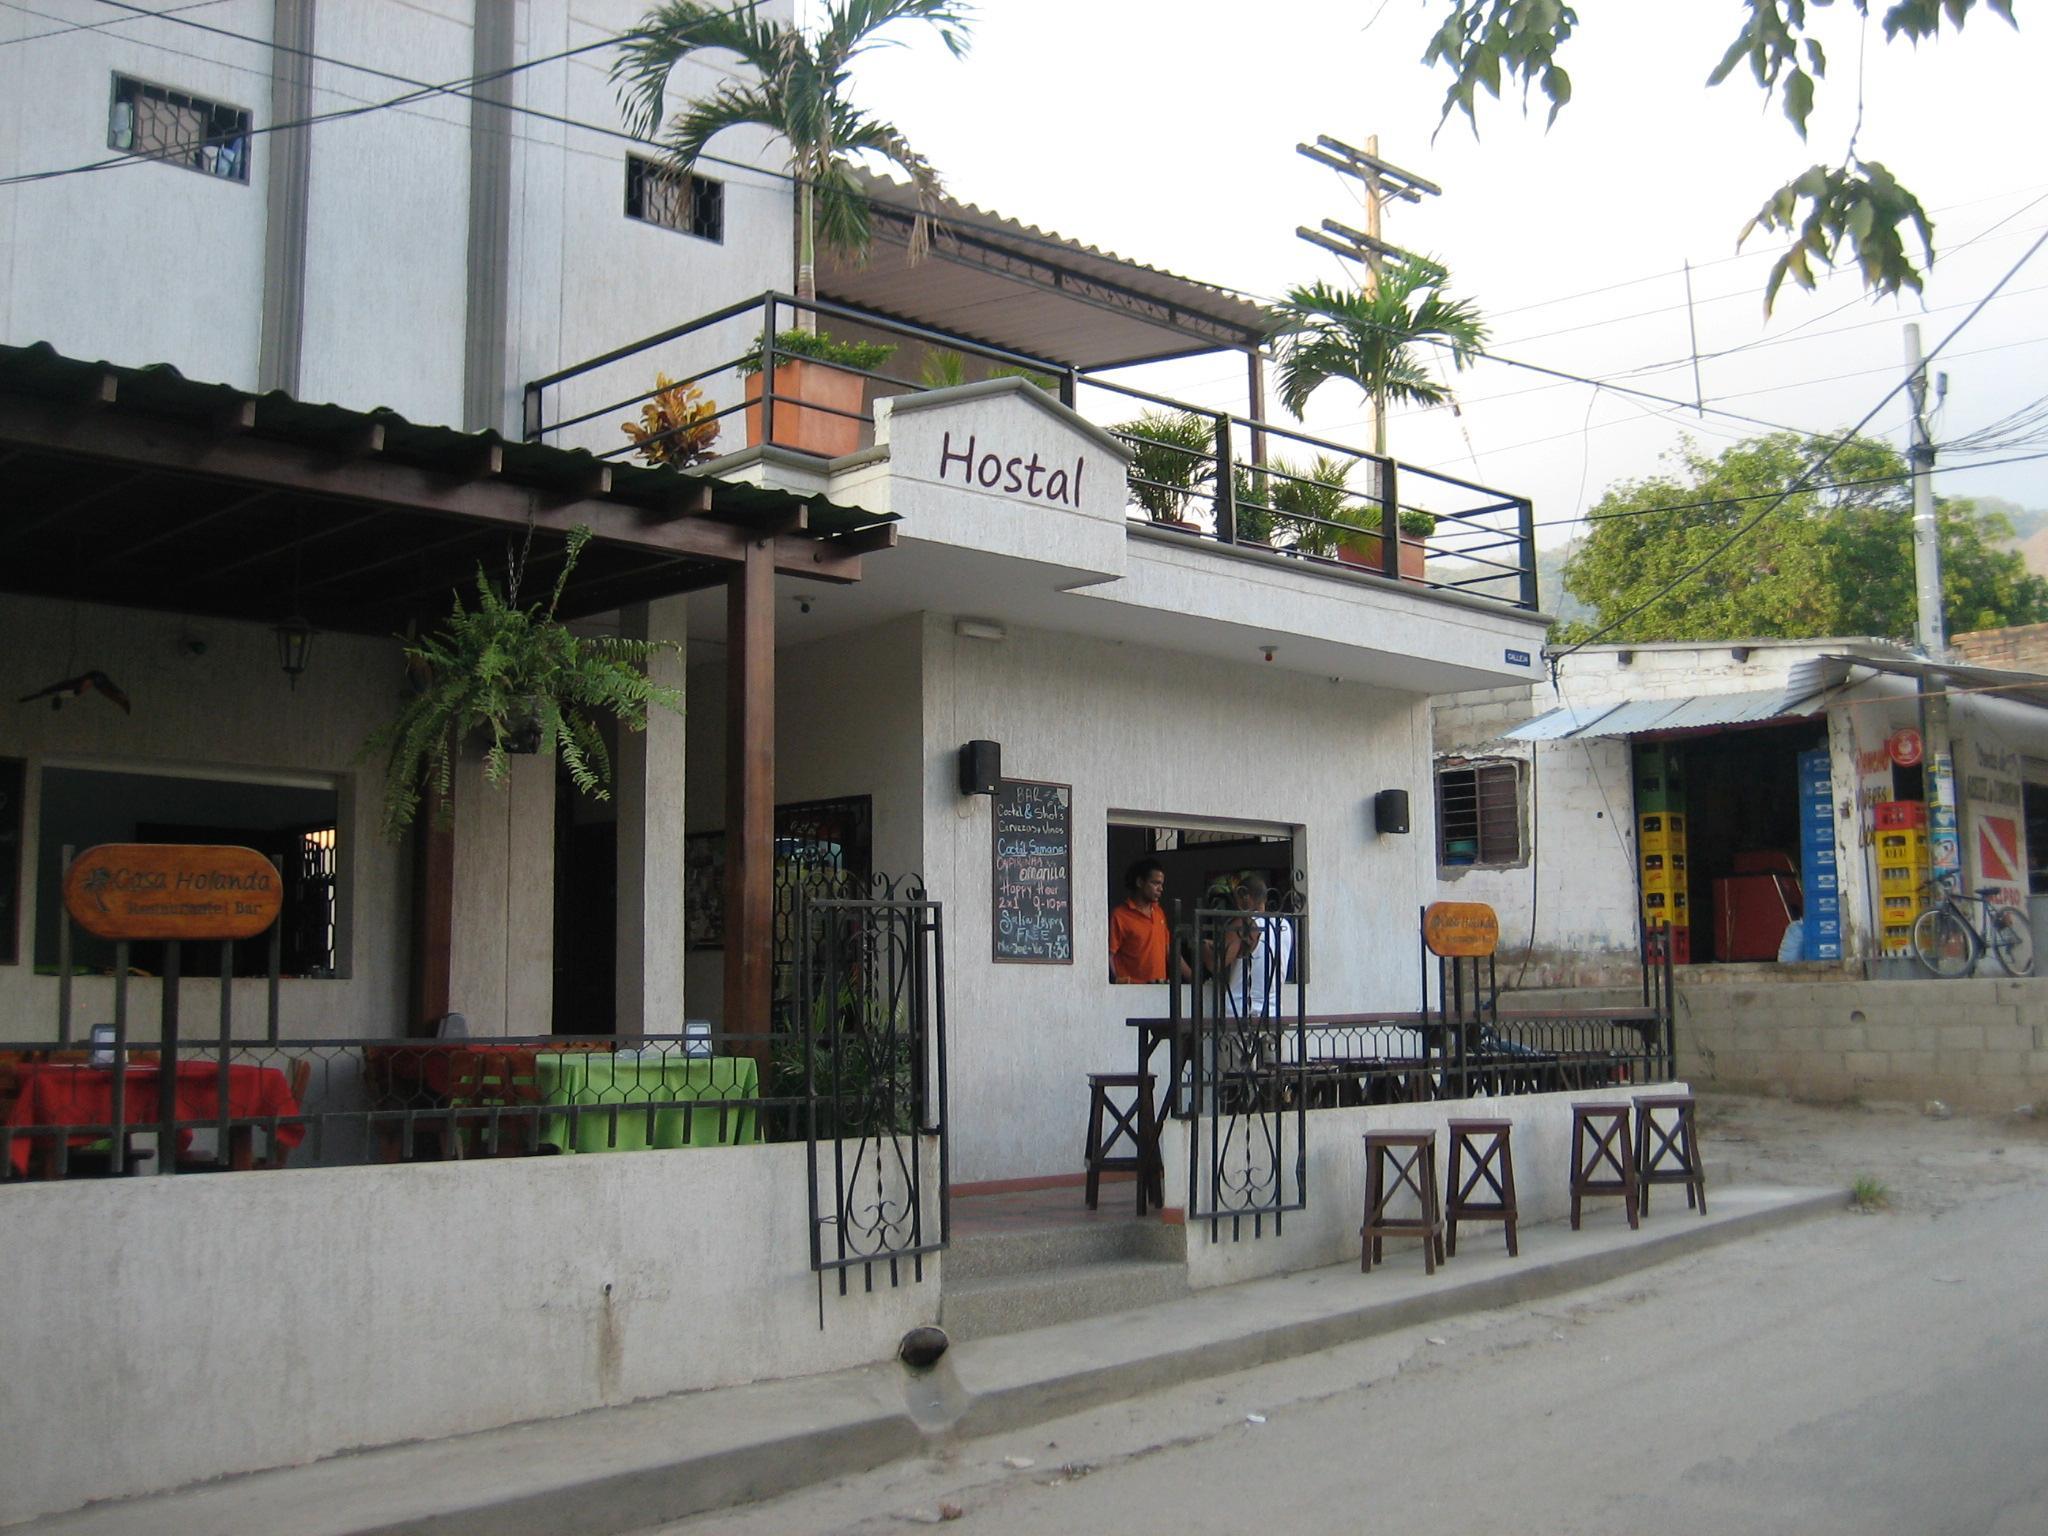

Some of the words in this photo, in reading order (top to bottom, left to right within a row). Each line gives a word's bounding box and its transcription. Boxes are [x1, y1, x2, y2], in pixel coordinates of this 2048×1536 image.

[939, 431, 1085, 508] Hostal
[1017, 786, 1042, 803] BAR
[1024, 803, 1033, 819] &
[112, 868, 168, 891] Casa
[176, 870, 273, 891] Holanda
[1000, 880, 1032, 899] Happy
[1036, 881, 1059, 895] Hour
[235, 901, 262, 915] Bar
[1017, 928, 1049, 942] FREE
